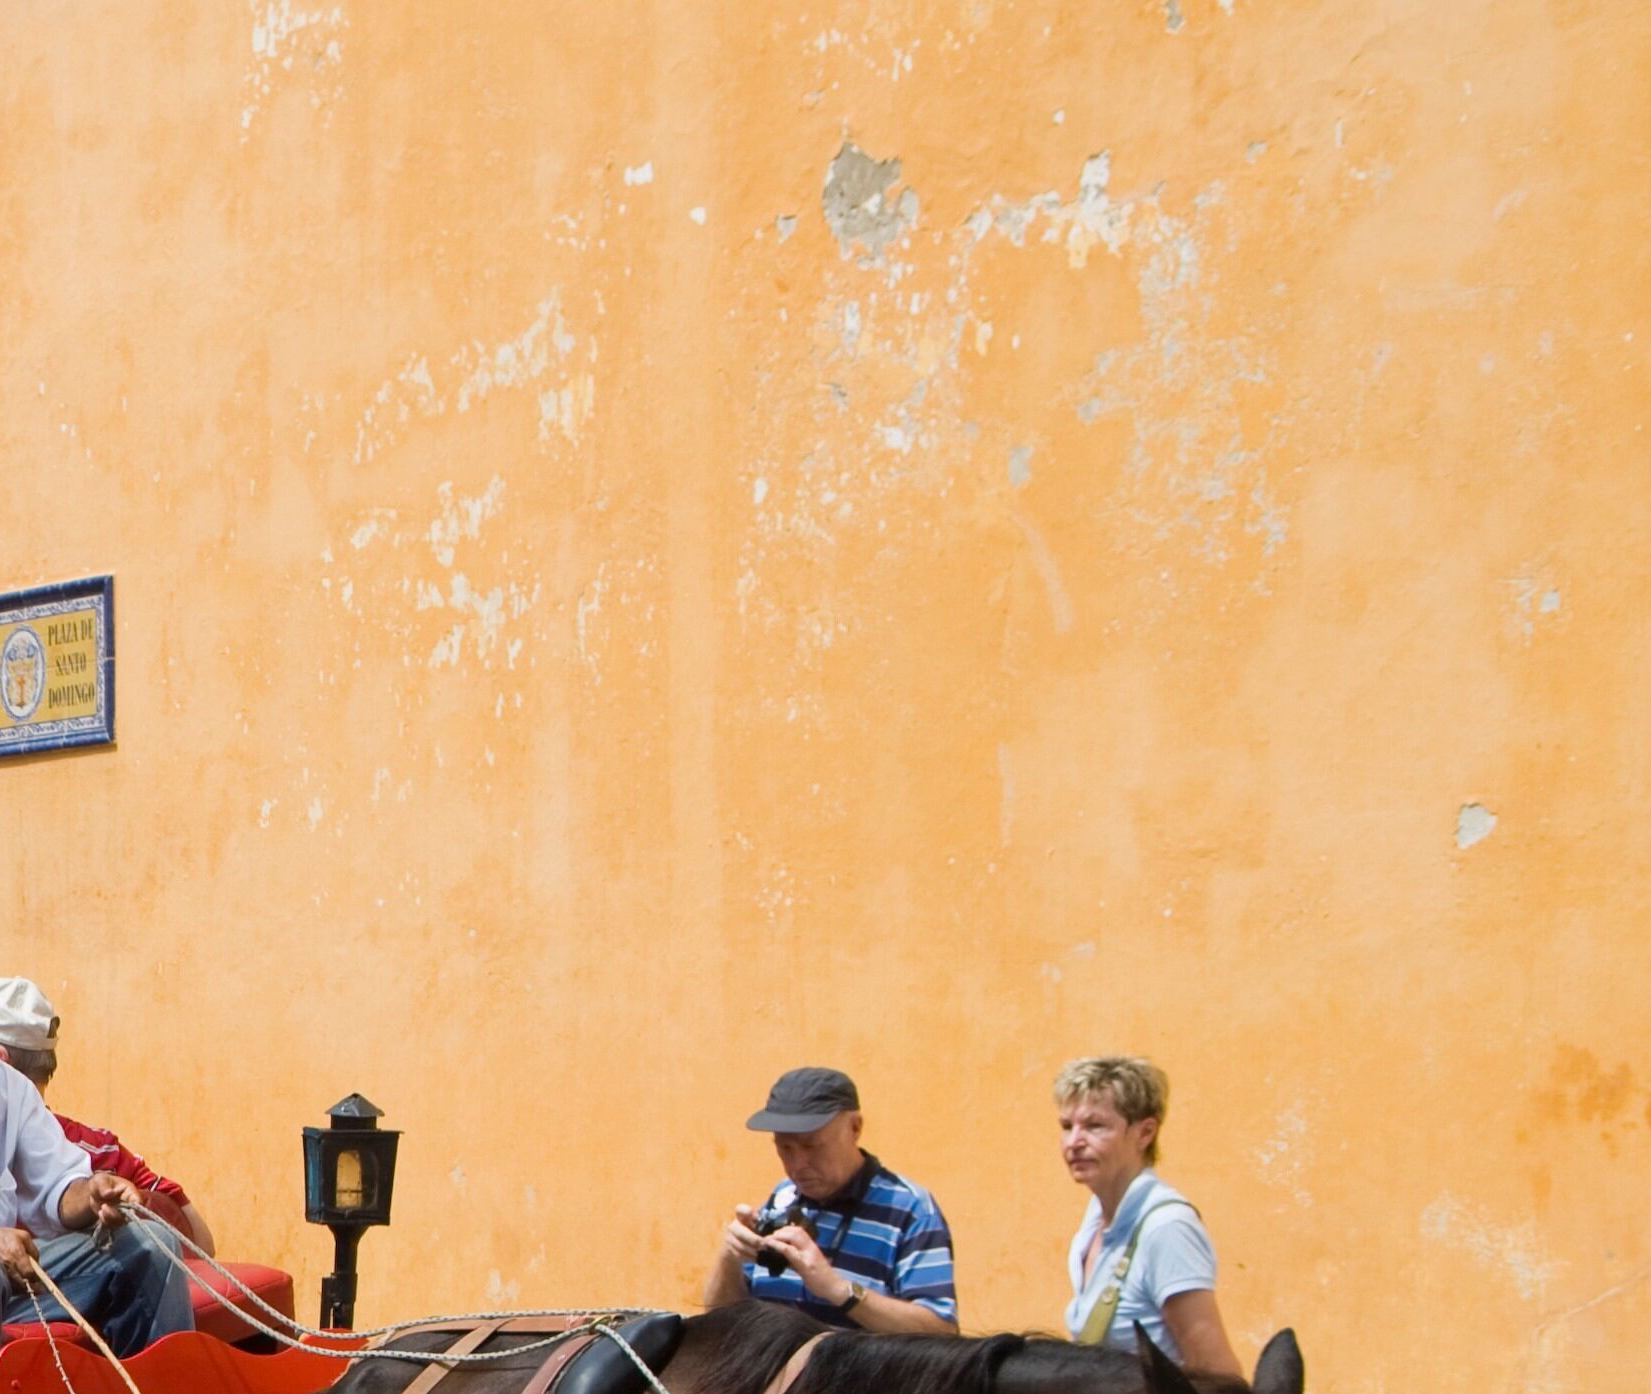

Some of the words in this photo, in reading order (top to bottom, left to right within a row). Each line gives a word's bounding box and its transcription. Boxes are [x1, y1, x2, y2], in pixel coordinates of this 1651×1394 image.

[48, 622, 79, 646] PLAZA
[81, 618, 94, 640] DE
[55, 652, 87, 676] SANTO
[48, 681, 95, 709] DOMINGO
